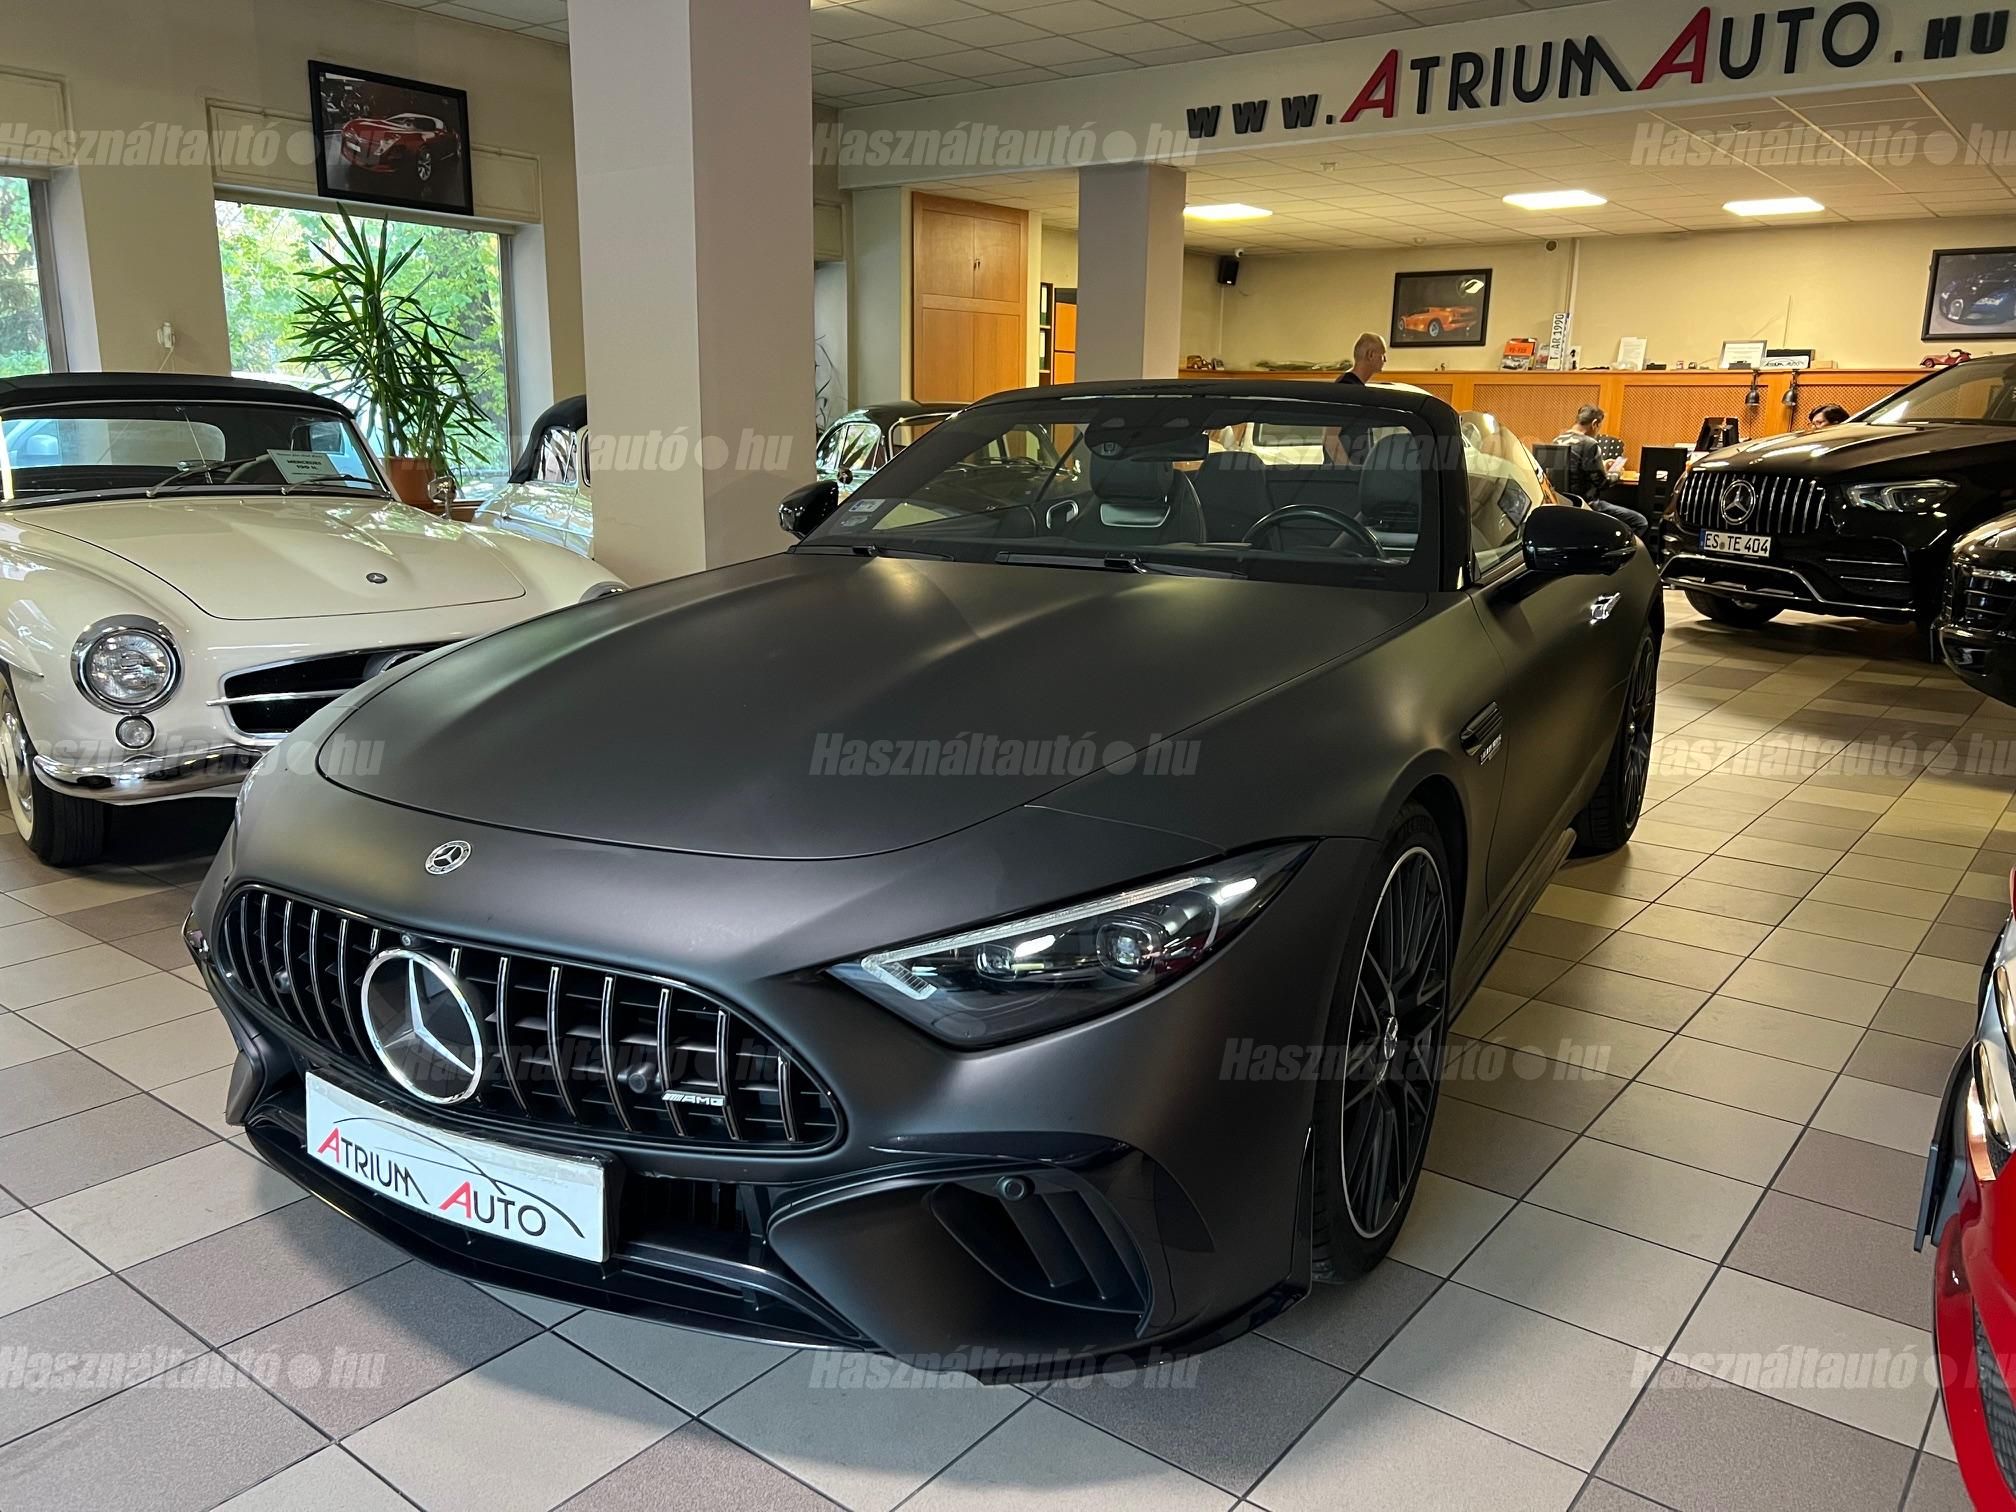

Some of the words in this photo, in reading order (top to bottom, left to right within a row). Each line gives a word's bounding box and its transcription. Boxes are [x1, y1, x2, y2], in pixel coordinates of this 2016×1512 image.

[1704, 533, 1720, 549] ES
[1727, 536, 1742, 551] TE
[1744, 537, 1769, 555] 404
[681, 1094, 724, 1107] AMG
[317, 1127, 430, 1205] ATRIUM
[438, 1180, 547, 1237] AUTO
